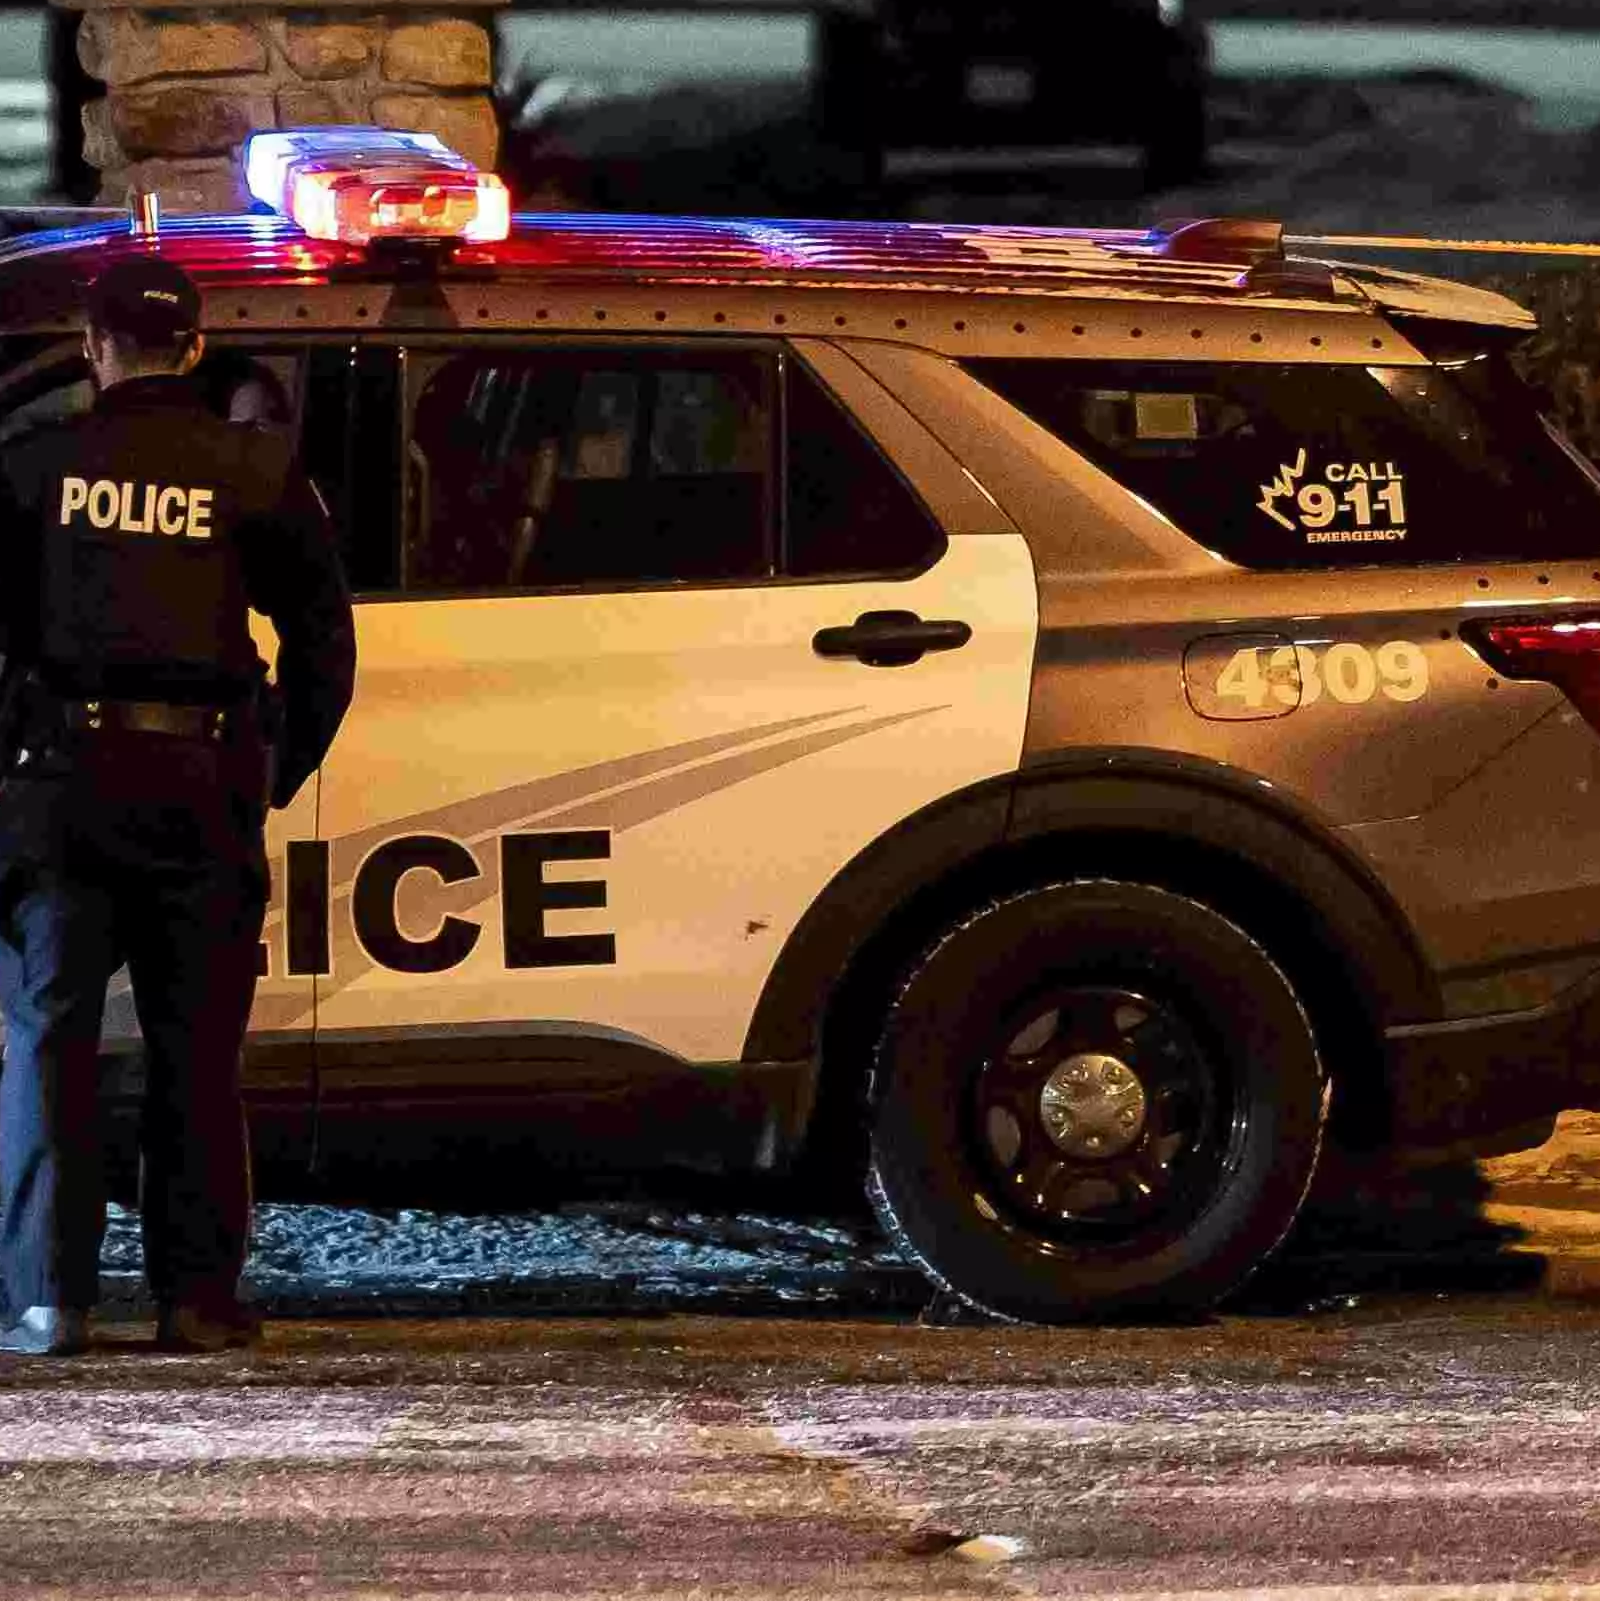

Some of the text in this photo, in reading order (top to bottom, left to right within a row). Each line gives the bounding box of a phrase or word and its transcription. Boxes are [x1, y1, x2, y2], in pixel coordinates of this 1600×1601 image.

[1324, 461, 1404, 482] CALL
[60, 477, 214, 538] POLICE
[1305, 528, 1408, 544] EMERGENCY
[1216, 640, 1429, 707] 4309
